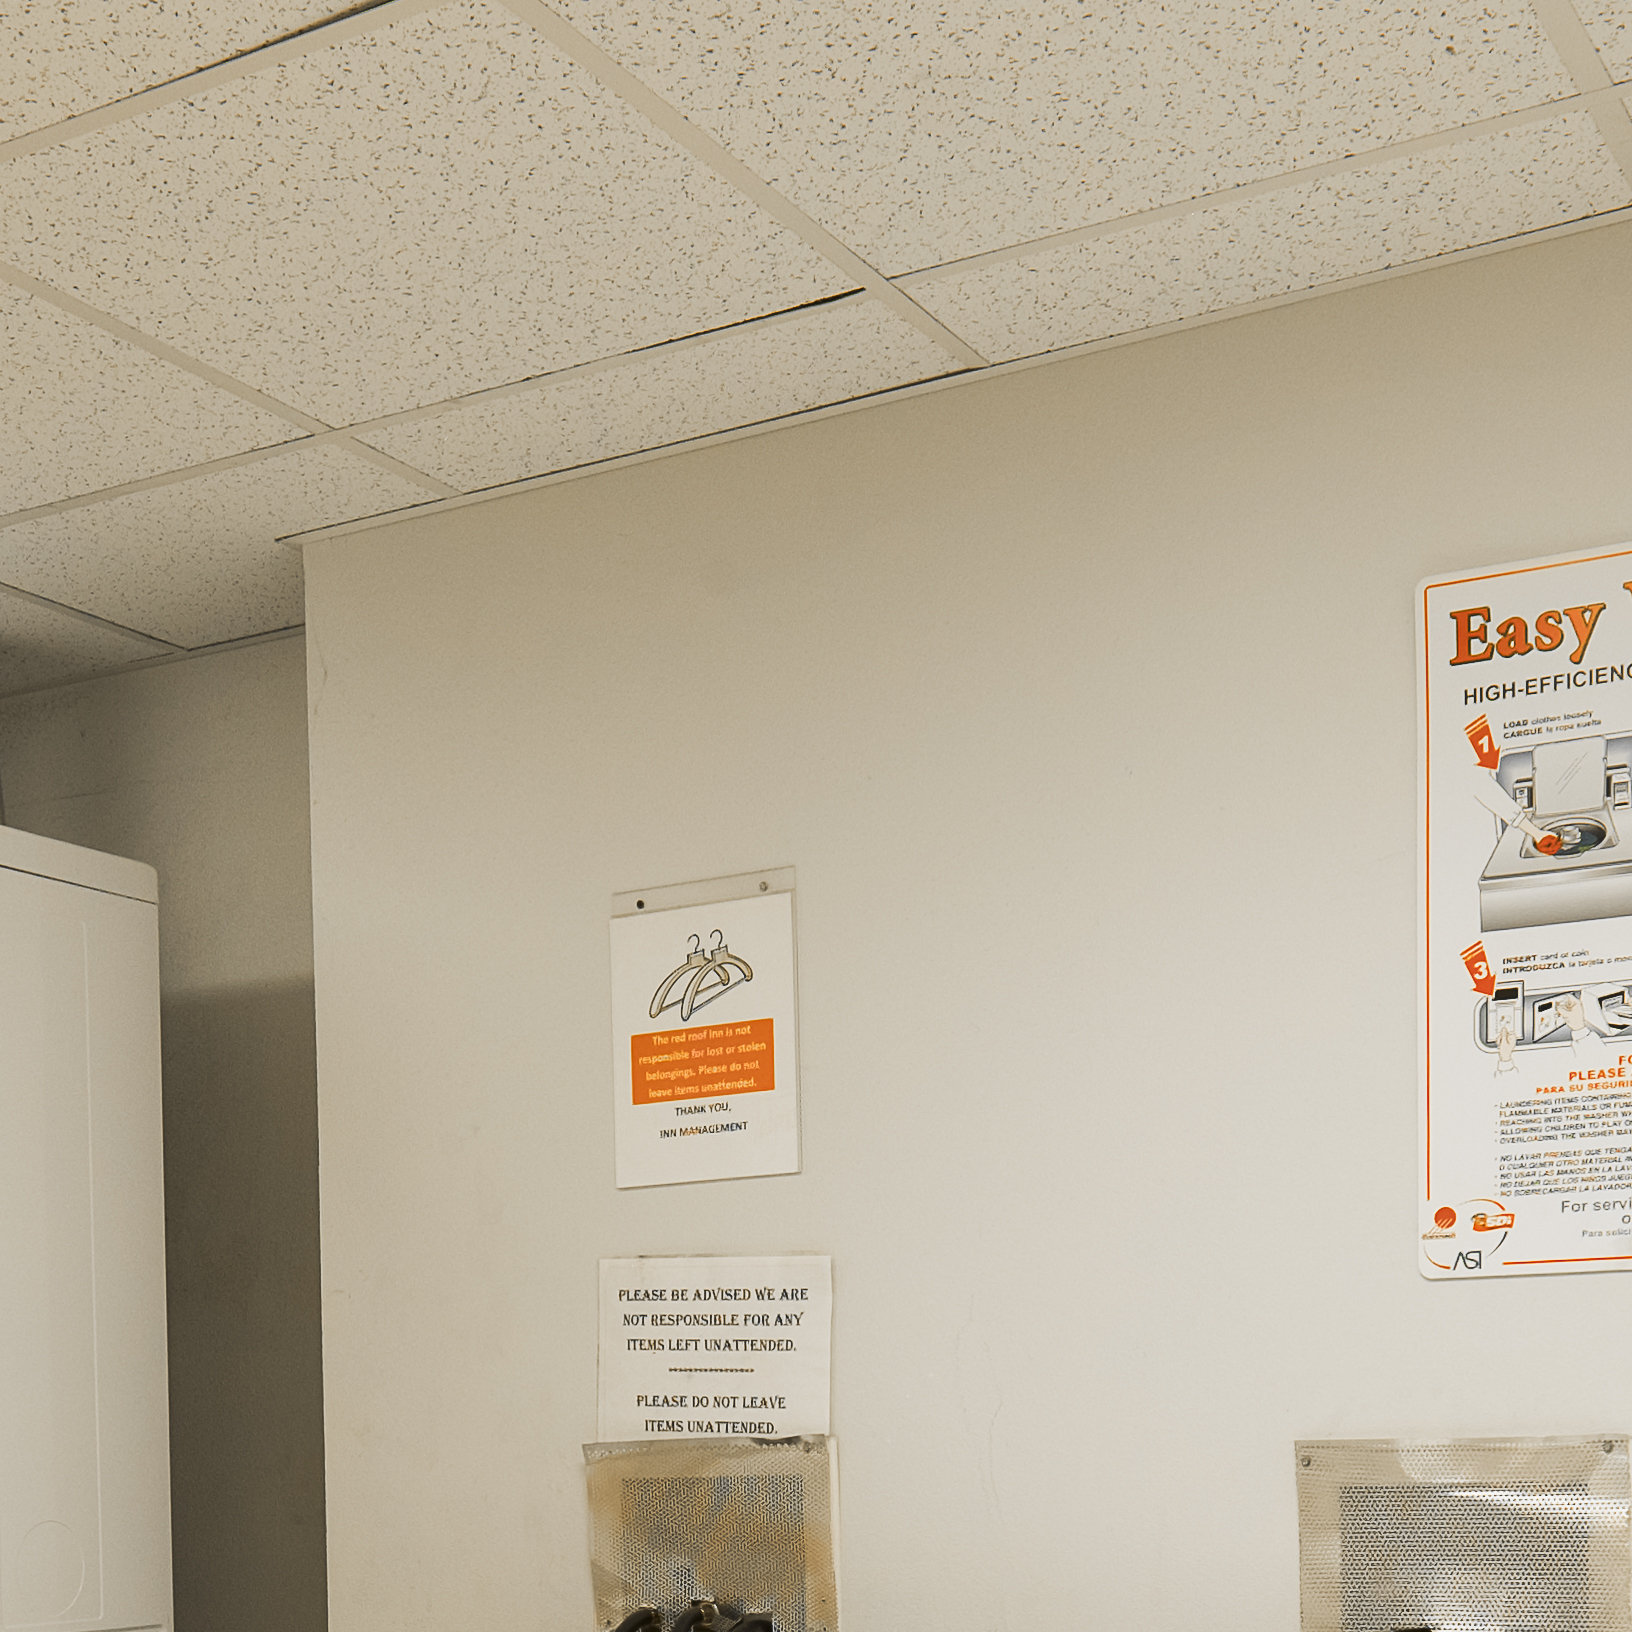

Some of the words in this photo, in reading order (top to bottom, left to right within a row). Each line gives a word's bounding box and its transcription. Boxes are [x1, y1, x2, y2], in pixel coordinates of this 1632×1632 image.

[1449, 602, 1606, 666] Easy
[1503, 719, 1528, 729] LOAD
[1477, 734, 1488, 754] 1
[1502, 954, 1536, 964] INSERT
[1473, 960, 1487, 980] 3
[652, 1035, 668, 1045] The
[670, 1031, 686, 1043] red
[687, 1029, 707, 1041] roof
[725, 1027, 732, 1037] is
[735, 1025, 751, 1035] not
[638, 1049, 689, 1064] responsible
[691, 1048, 704, 1058] for
[706, 1046, 723, 1056] lost
[725, 1046, 735, 1054] or
[737, 1041, 766, 1053] stolen
[697, 1064, 727, 1074] Please
[729, 1062, 741, 1071] do
[743, 1059, 760, 1070] not
[1568, 1067, 1625, 1081] PLEASE
[648, 1088, 672, 1098] leave
[701, 1076, 756, 1092] unattended.
[1569, 1084, 1583, 1092] SU
[675, 1105, 706, 1116] THANK
[659, 1128, 676, 1138] INN
[679, 1121, 747, 1136] MANAGEMENT
[1561, 1200, 1587, 1213] For
[618, 1289, 667, 1301] PLEASE
[671, 1288, 688, 1301] BE
[692, 1287, 750, 1300] ADVISED
[754, 1287, 775, 1300] WE
[780, 1288, 808, 1300] ARE
[623, 1313, 647, 1325] NOT
[651, 1314, 739, 1326] RESPONSIBLE
[743, 1313, 769, 1326] FOR
[774, 1311, 803, 1326] ANY
[627, 1338, 664, 1350] ITEMS
[668, 1338, 700, 1351] LEFT
[704, 1339, 795, 1351] UNATTENDED.
[636, 1395, 687, 1407] PLEASE
[692, 1395, 709, 1407] DO
[713, 1396, 738, 1408] NOT
[742, 1395, 786, 1409] LEAVE
[645, 1419, 683, 1432] ITEMS
[687, 1420, 777, 1434] UNATTENDED.
